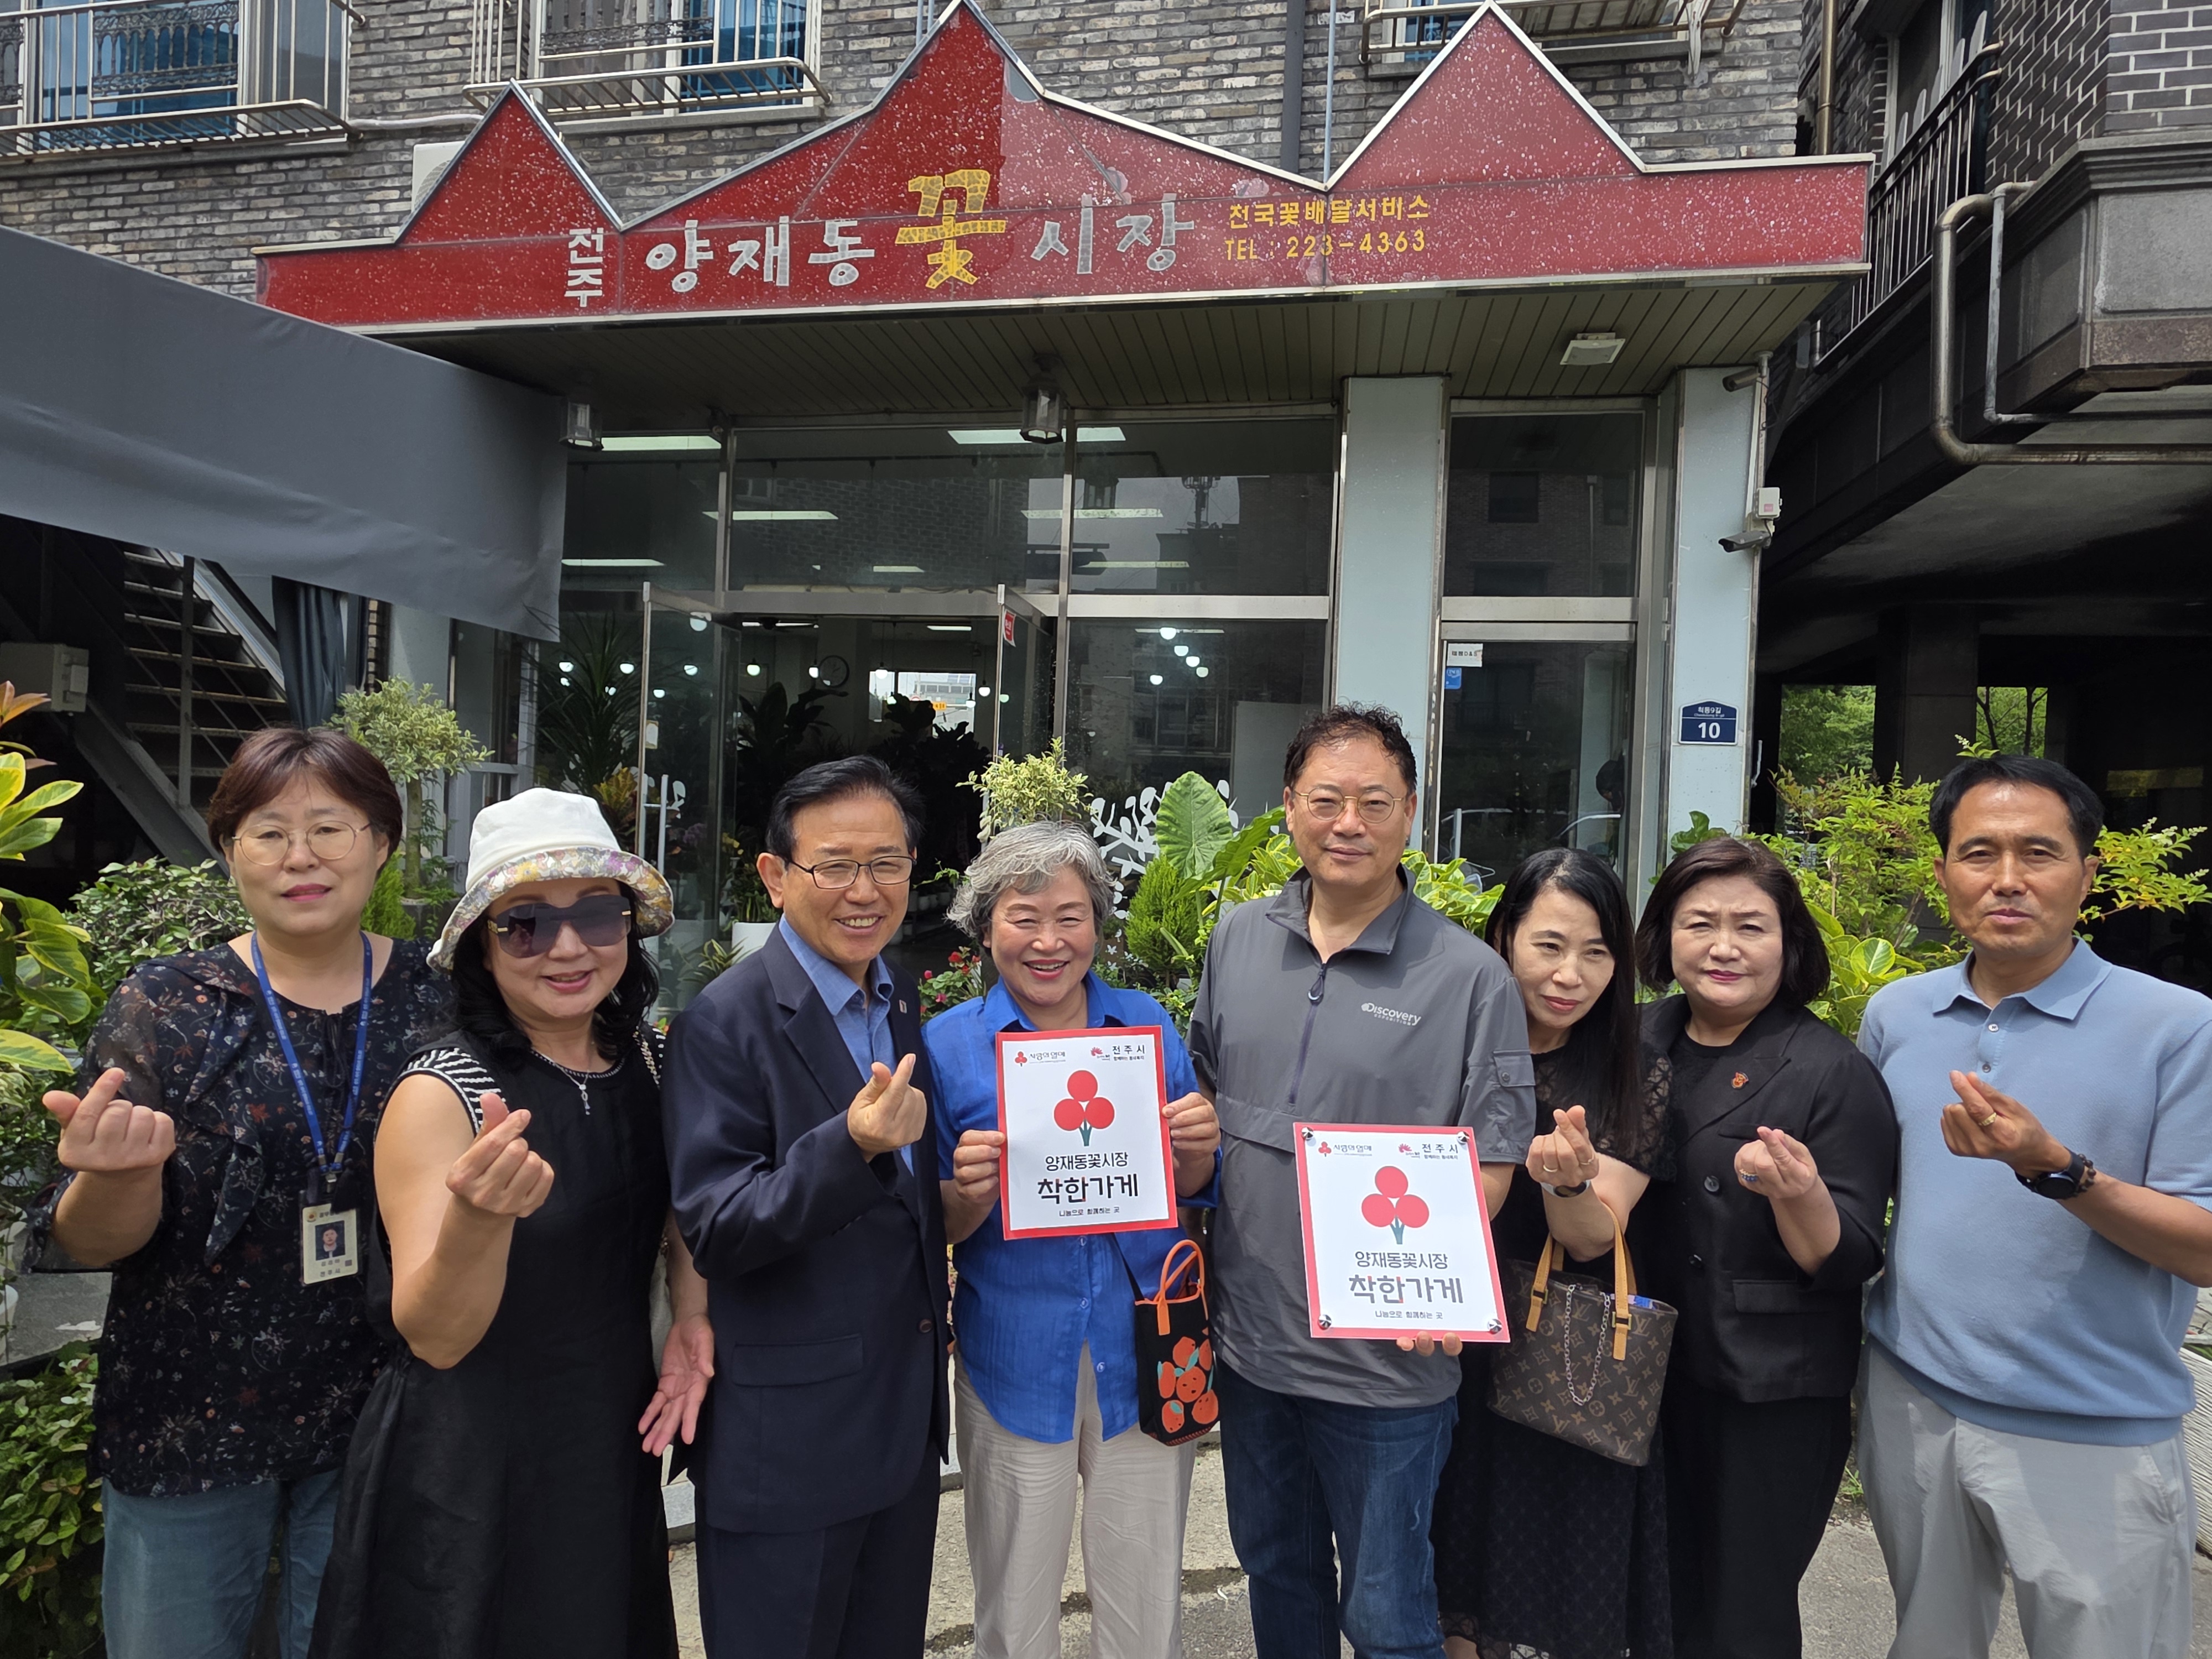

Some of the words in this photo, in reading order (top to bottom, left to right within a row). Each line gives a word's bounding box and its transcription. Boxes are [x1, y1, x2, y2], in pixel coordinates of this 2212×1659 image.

[1286, 229, 1425, 258] 223-4363
[564, 226, 603, 307] 전주
[1698, 722, 1720, 739] 10
[1361, 1002, 1422, 1026] Discovery
[1045, 1152, 1129, 1171] 양재동꽃시장
[1037, 1173, 1139, 1204] 착한가게
[1355, 1251, 1448, 1269] 양재동꽃시장
[1349, 1274, 1464, 1304] 착한가게
[1375, 1310, 1403, 1318] 나눔으로
[1406, 1311, 1433, 1319] 함께하는
[1436, 1311, 1443, 1319] 곳
